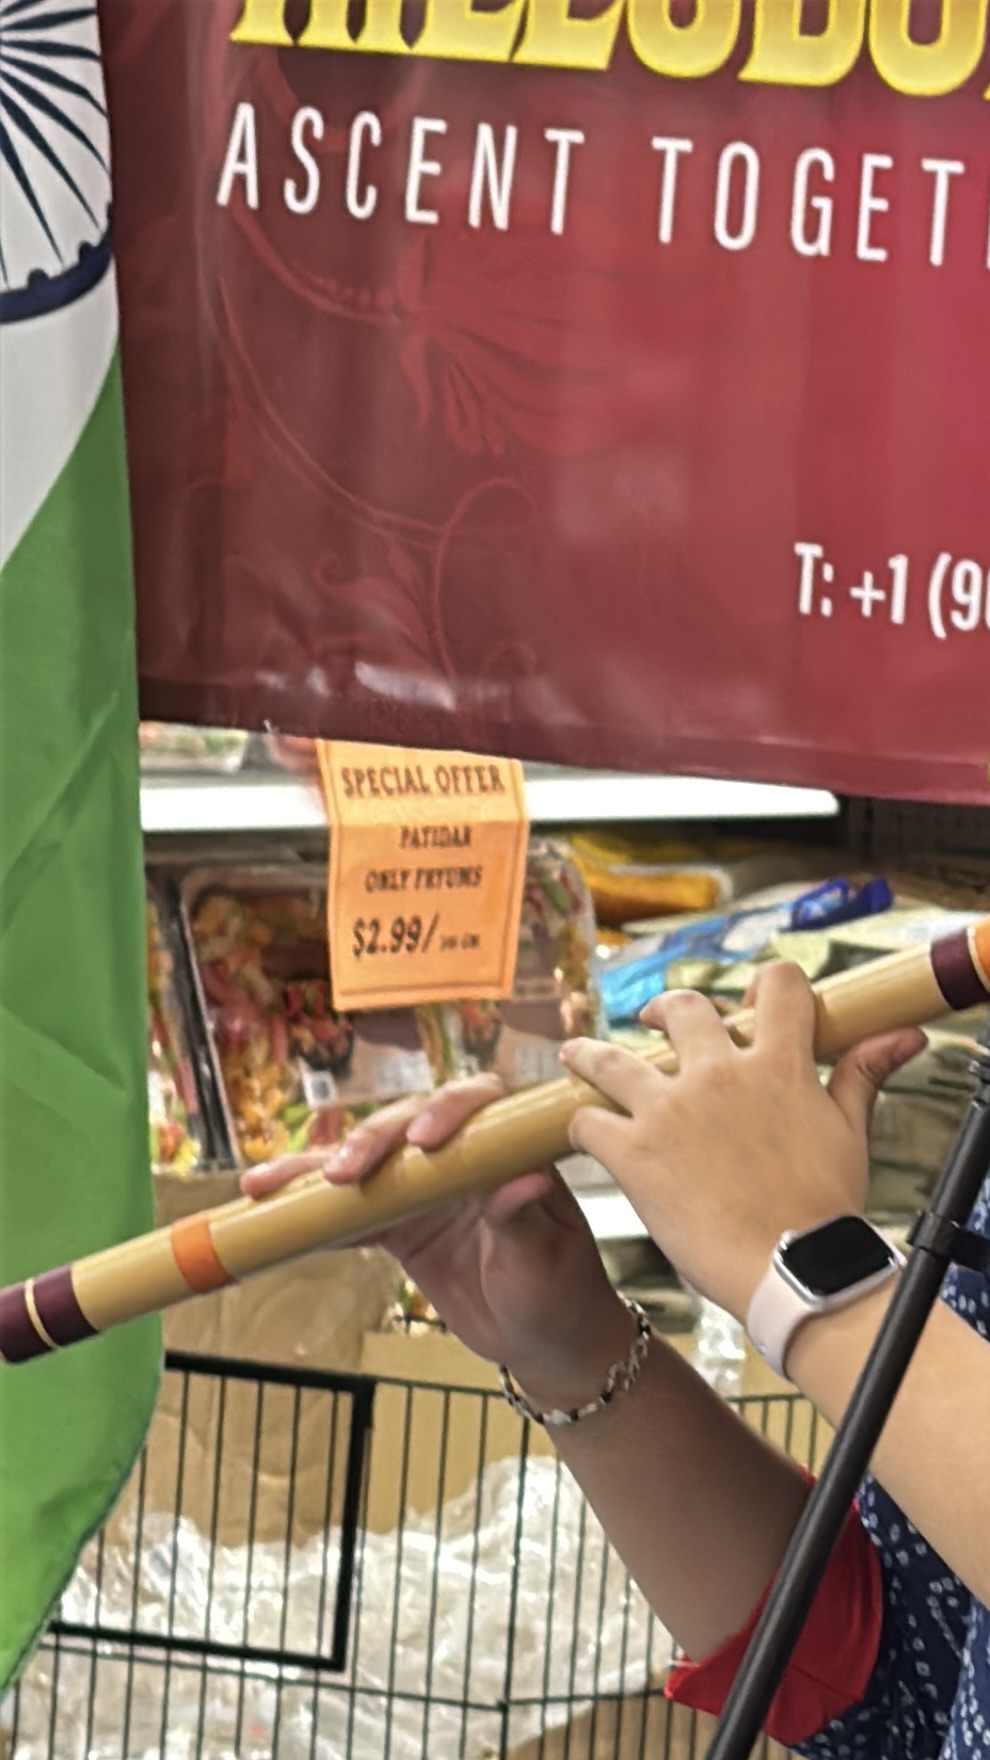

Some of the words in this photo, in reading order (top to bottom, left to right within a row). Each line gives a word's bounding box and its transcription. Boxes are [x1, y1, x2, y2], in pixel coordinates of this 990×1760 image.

[216, 102, 586, 236] ASCENT
[794, 541, 835, 617] T:
[849, 553, 909, 625] +1
[341, 764, 430, 799] SPECIAL
[433, 763, 506, 796] OFFER
[365, 868, 410, 893] ONLY
